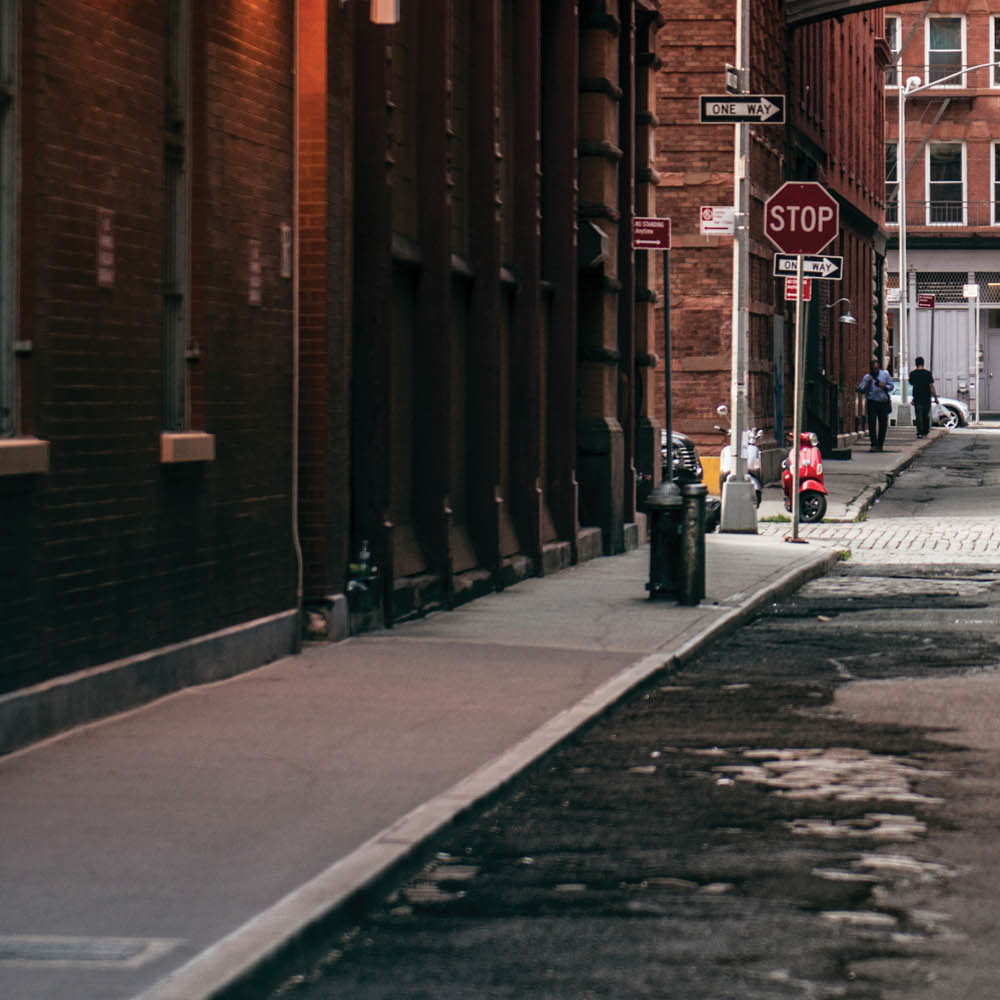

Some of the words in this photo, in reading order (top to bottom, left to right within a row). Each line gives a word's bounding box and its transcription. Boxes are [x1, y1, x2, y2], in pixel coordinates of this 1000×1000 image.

[712, 104, 736, 115] ONE
[747, 104, 772, 115] WAY
[769, 205, 833, 233] STOP
[784, 260, 798, 270] ON
[812, 263, 832, 272] WAY
